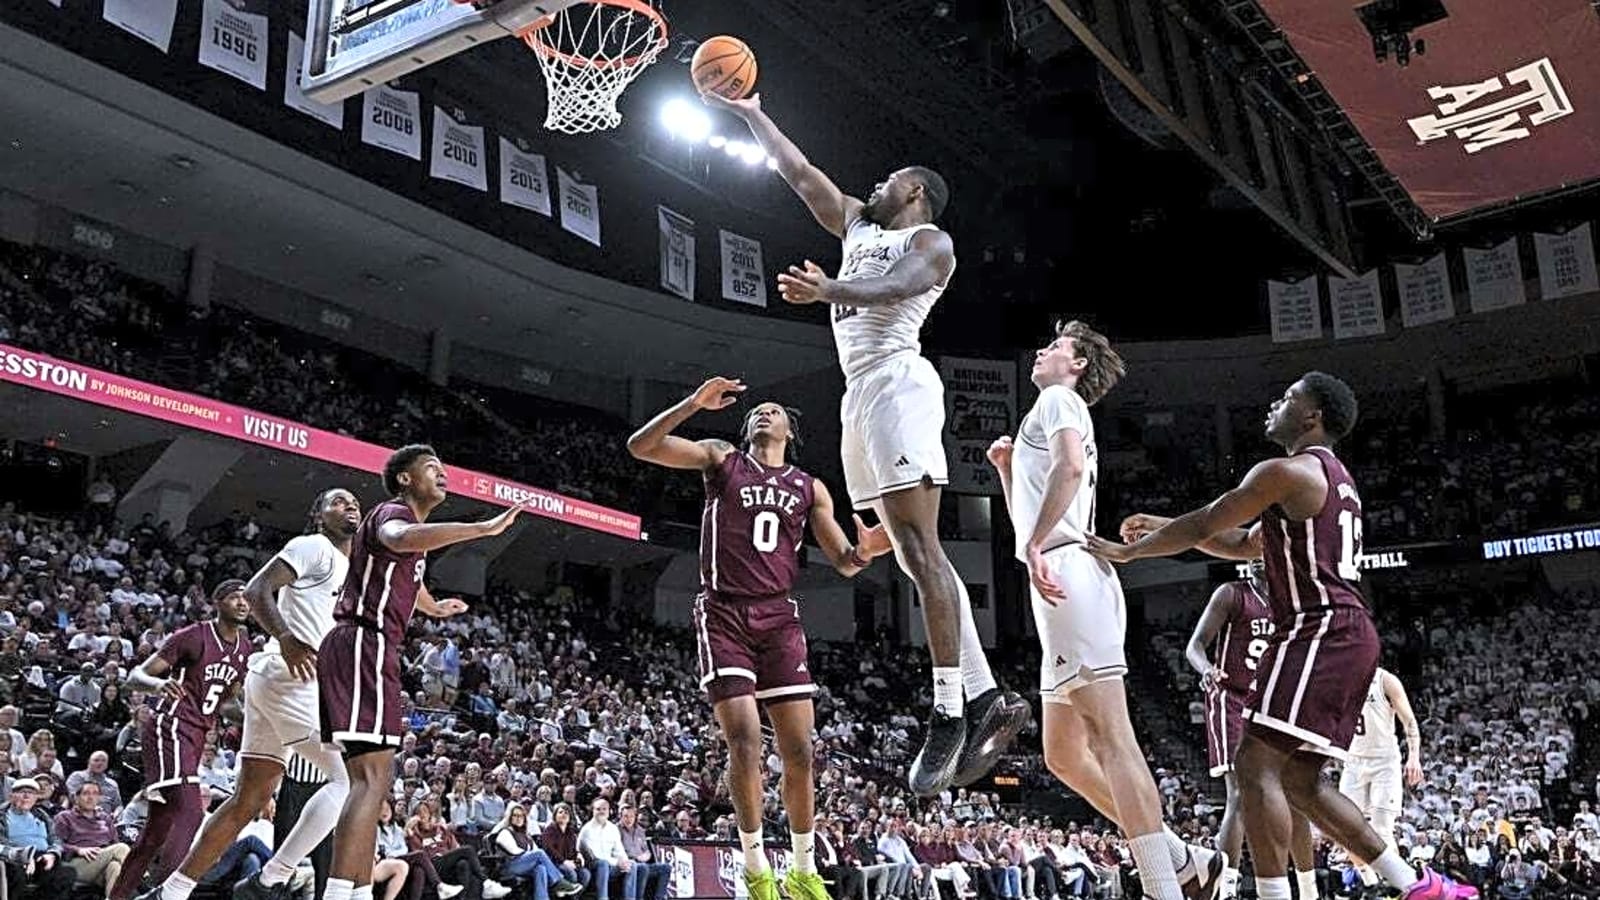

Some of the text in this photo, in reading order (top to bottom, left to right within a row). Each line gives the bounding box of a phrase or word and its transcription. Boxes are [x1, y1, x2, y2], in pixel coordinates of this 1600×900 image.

[373, 106, 413, 135] 2008
[443, 141, 477, 167] 2010
[510, 168, 542, 193] 2013
[90, 379, 105, 390] BY
[106, 384, 151, 403] JOHNSON
[153, 395, 220, 422] DEVELOPMENT
[243, 415, 285, 442] VISIT
[288, 427, 308, 449] US
[494, 483, 564, 513] KRESSTON
[740, 486, 800, 515] STATE
[753, 511, 780, 552] 0
[1483, 540, 1511, 559] BUY
[1513, 533, 1573, 555] TICKETS
[202, 684, 224, 715] 5
